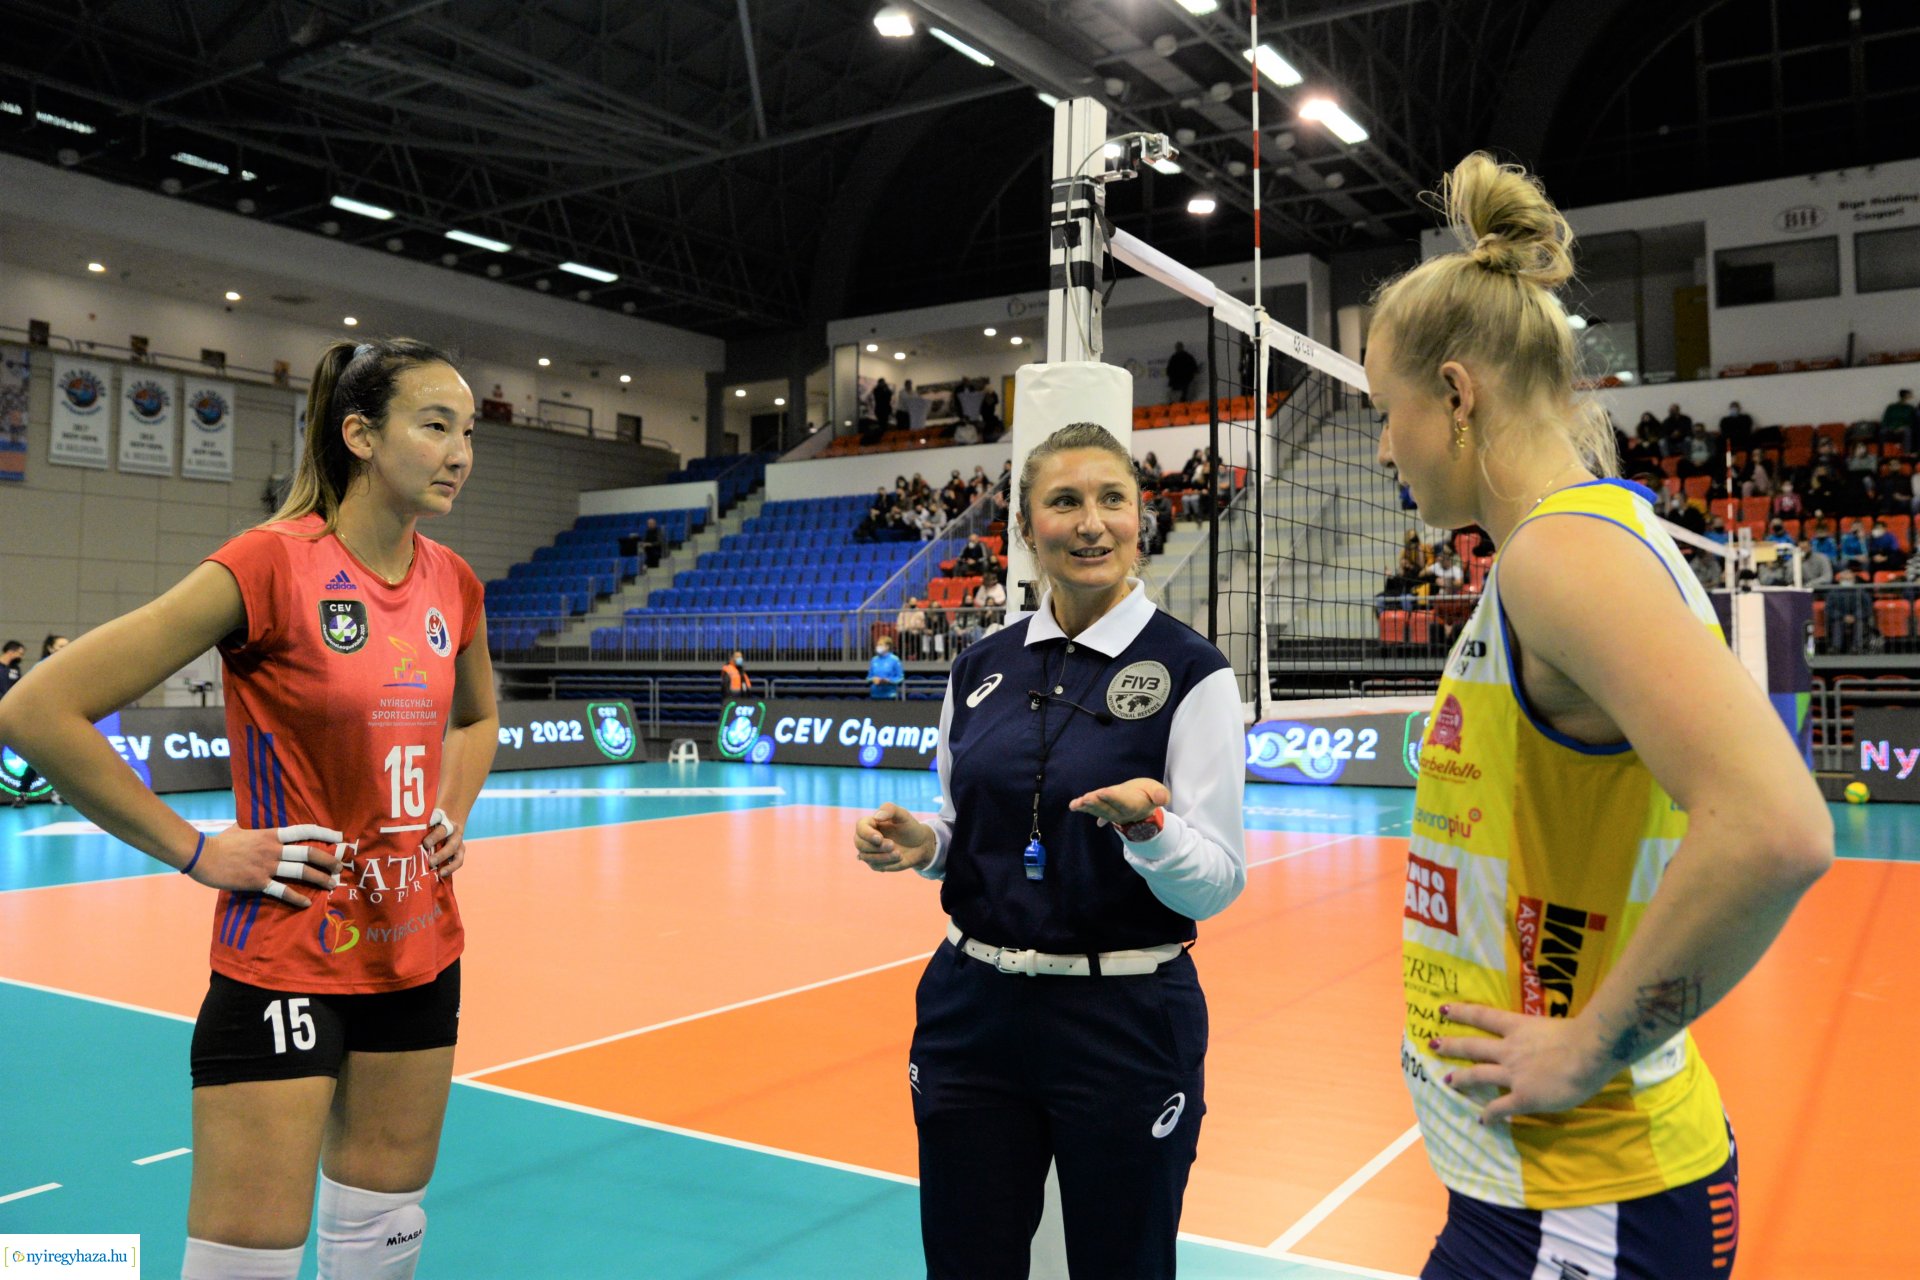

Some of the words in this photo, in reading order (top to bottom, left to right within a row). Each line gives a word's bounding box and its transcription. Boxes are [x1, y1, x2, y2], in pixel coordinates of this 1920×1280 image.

[329, 604, 351, 612] CEV
[1121, 674, 1161, 691] FIVB
[372, 711, 437, 720] SPORTCENTRUM
[735, 706, 755, 717] CEV
[1137, 702, 1162, 718] REFEREE
[530, 720, 584, 743] 2022
[774, 717, 832, 744] CEV
[838, 717, 939, 754] Champ
[1284, 727, 1378, 760] 2022
[384, 745, 426, 818] 15
[263, 998, 316, 1054] 15
